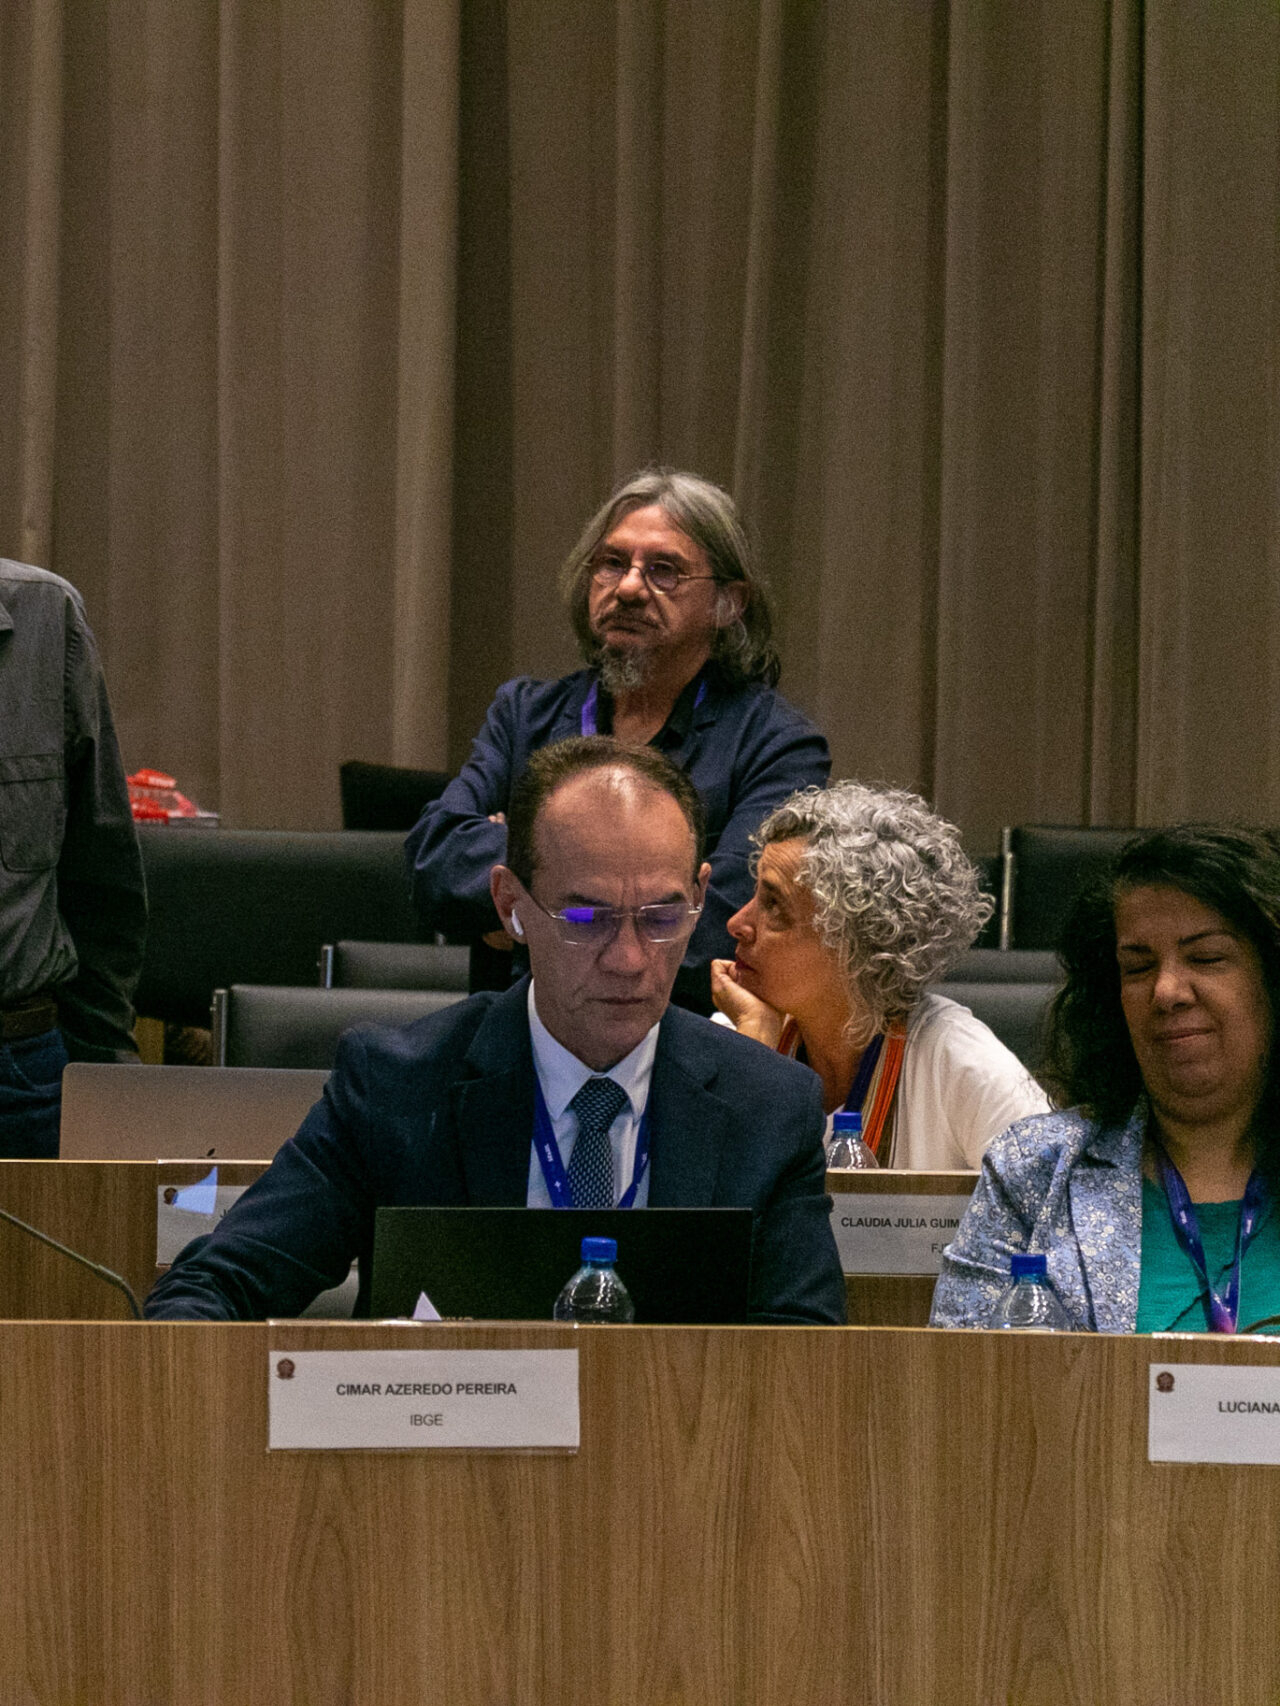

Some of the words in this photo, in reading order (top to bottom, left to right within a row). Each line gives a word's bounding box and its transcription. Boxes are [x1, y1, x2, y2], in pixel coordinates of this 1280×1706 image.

[840, 1217, 892, 1228] CLAUDIA
[894, 1218, 927, 1228] JULIA
[336, 1384, 382, 1396] CIMAR
[384, 1383, 453, 1396] AZEREDO
[456, 1383, 517, 1395] PEREIRA
[1218, 1401, 1280, 1413] LUCIANA
[410, 1414, 444, 1427] IBGE
